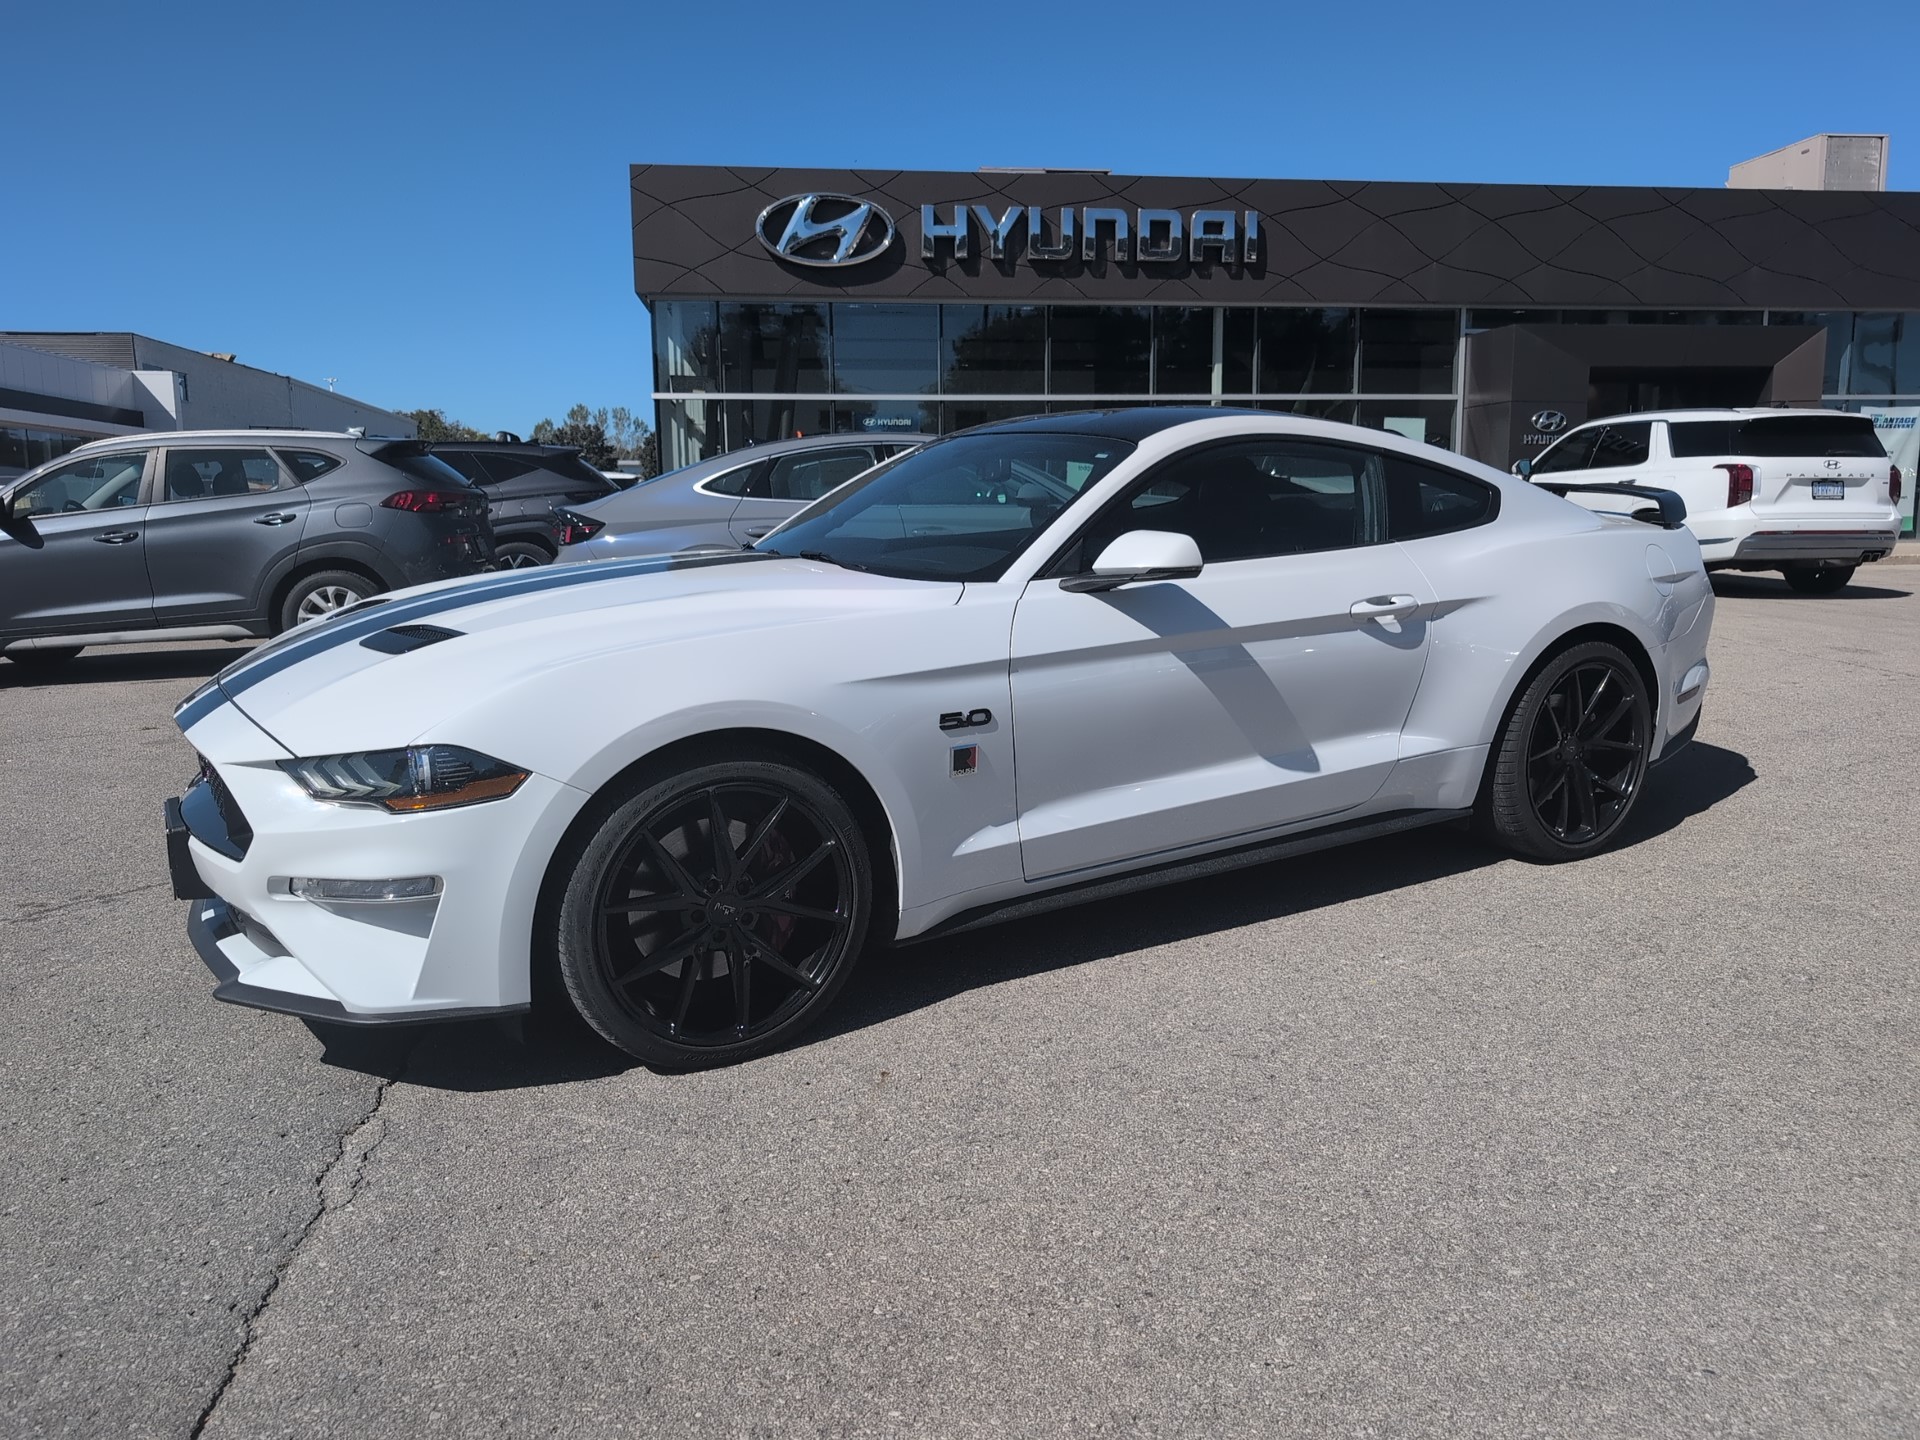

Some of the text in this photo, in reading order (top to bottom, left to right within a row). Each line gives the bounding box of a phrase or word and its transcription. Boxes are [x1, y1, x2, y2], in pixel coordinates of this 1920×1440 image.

[921, 203, 1259, 263] HYUNDAI
[877, 418, 912, 426] HYUNDAI
[1523, 434, 1561, 445] HYUN
[939, 708, 992, 731] 5.0
